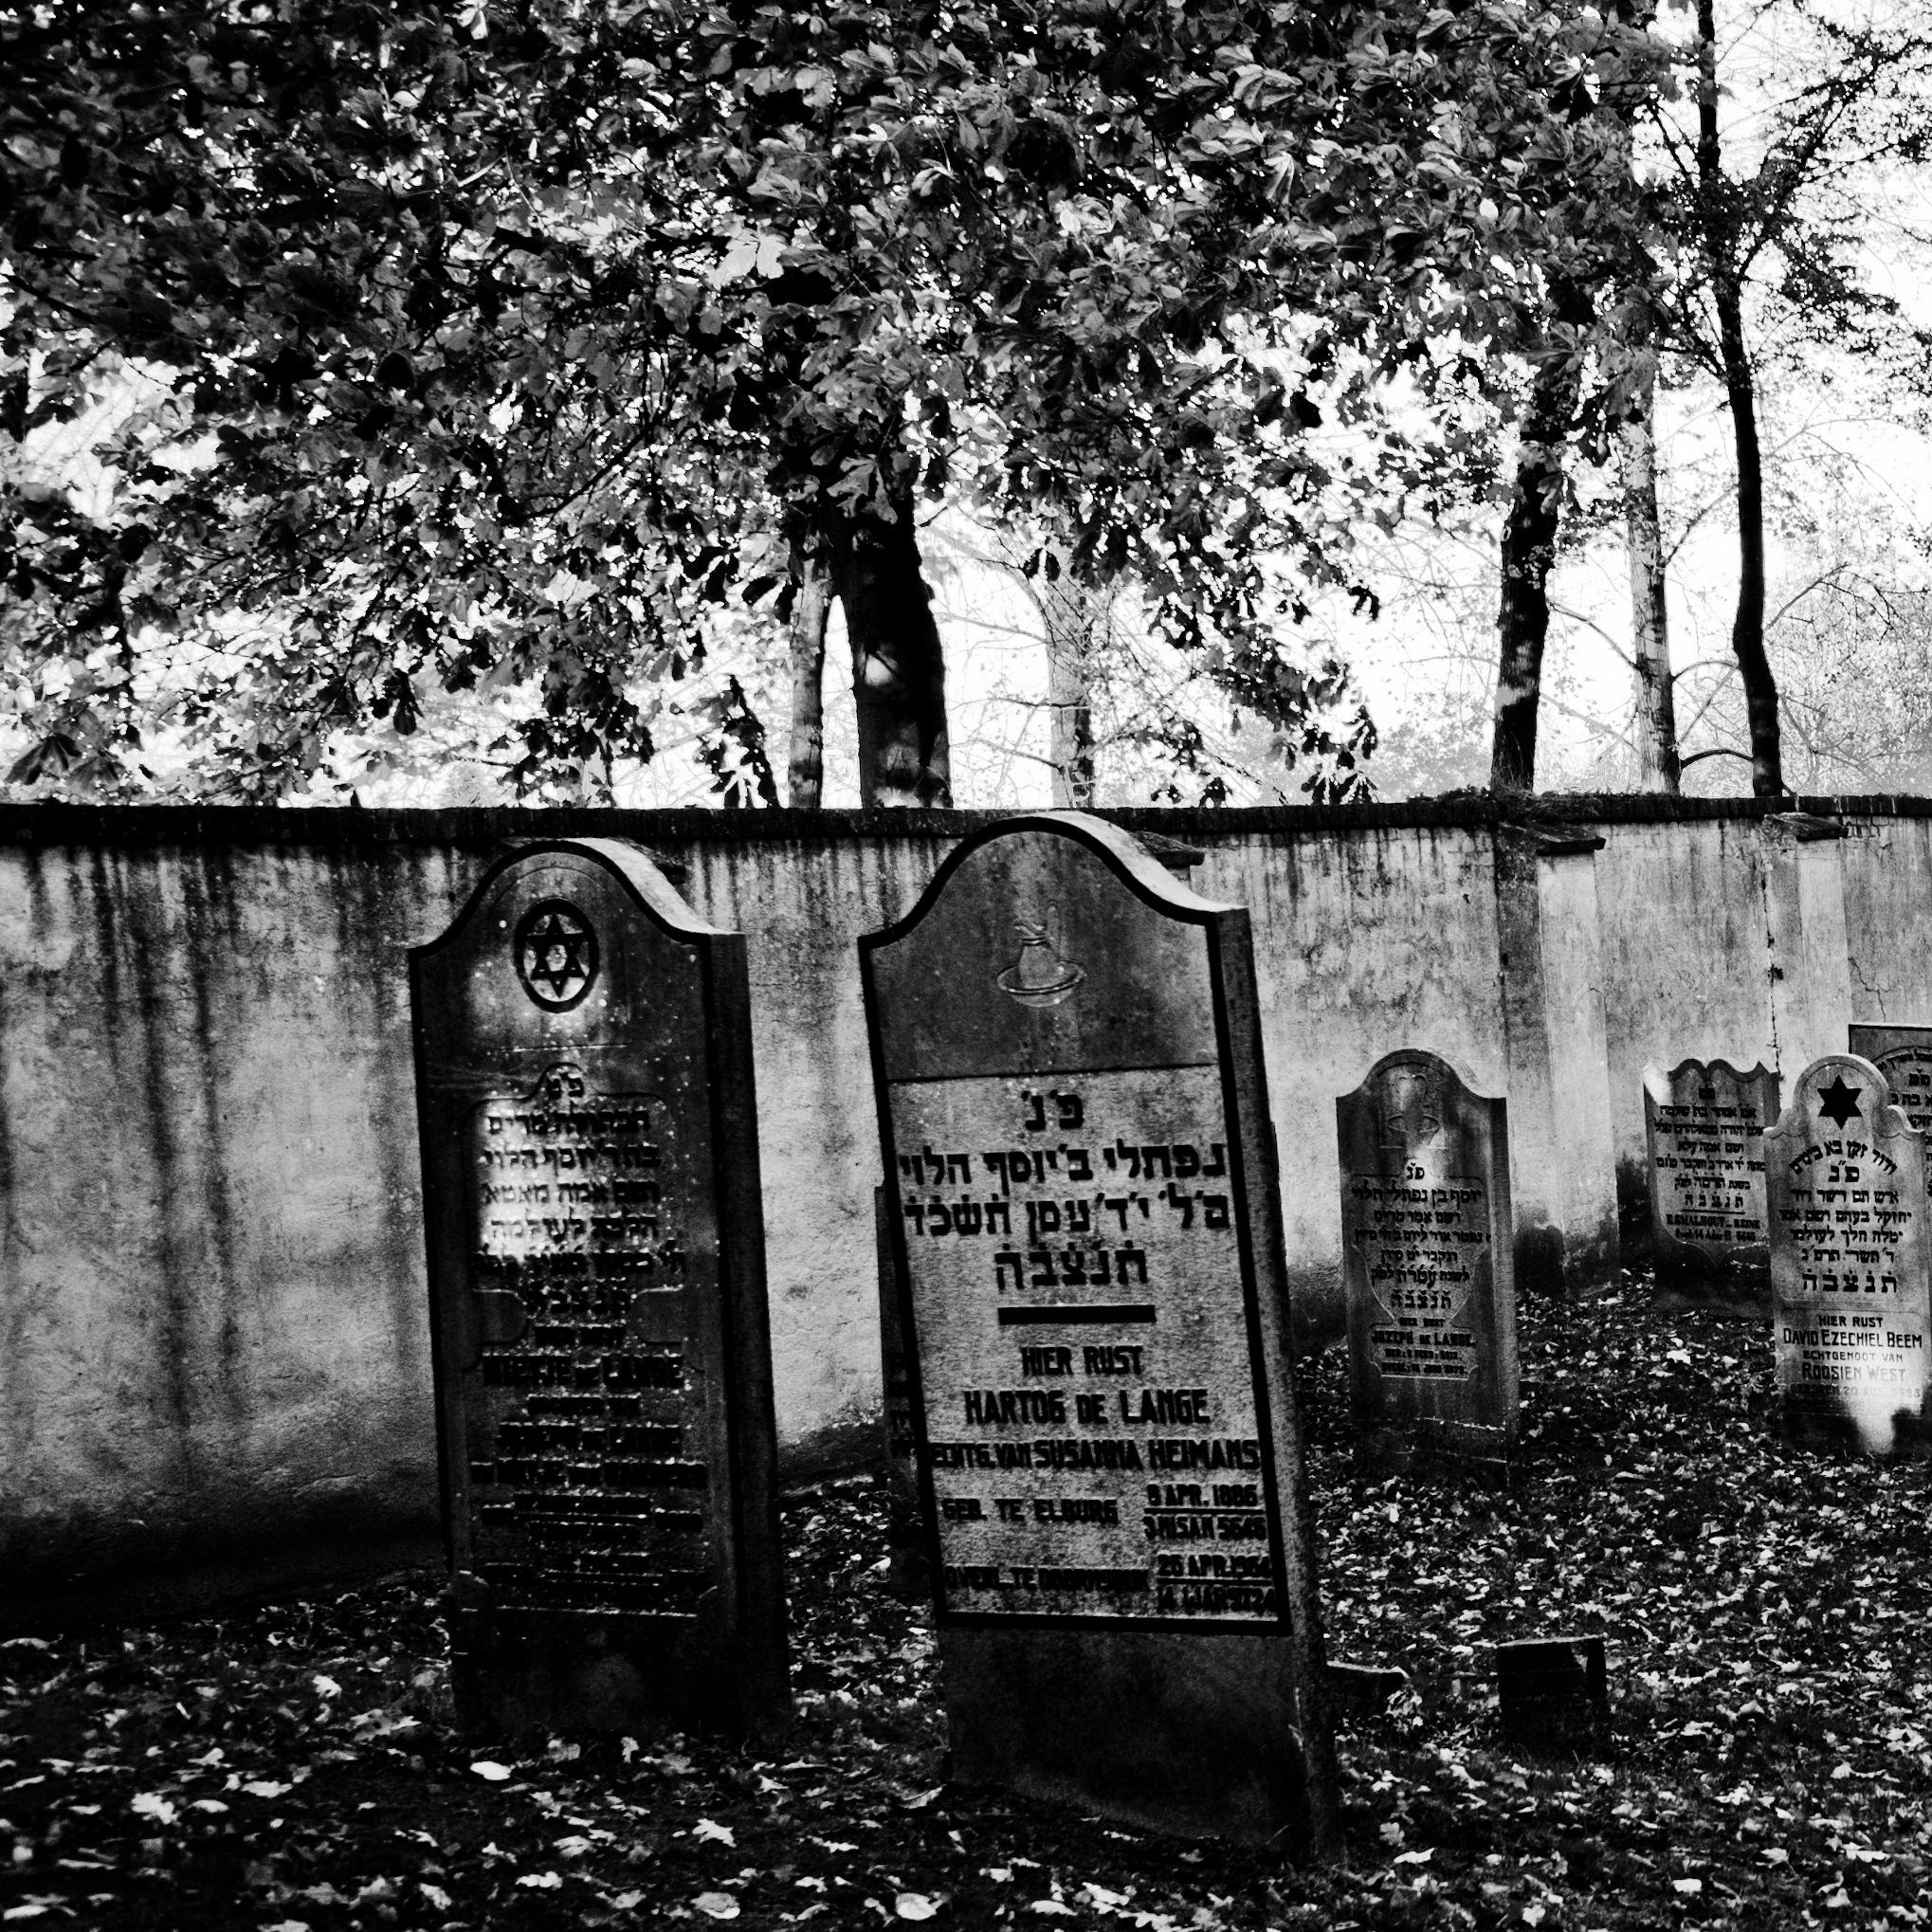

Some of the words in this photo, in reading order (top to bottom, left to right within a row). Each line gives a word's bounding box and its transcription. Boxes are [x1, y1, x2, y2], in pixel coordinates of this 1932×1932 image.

[1103, 1139, 1227, 1178] נפתלי
[1824, 1139, 1843, 1157] בא
[1846, 1140, 1868, 1159] זקן
[899, 1146, 972, 1185] הלוי
[1351, 1179, 1383, 1200] הלוי
[1387, 1179, 1428, 1202] נפתלי
[1431, 1189, 1448, 1209] בן
[1450, 1188, 1482, 1210] יוסף
[1816, 1190, 1847, 1203] וישר
[1852, 1190, 1869, 1203] תם
[1874, 1191, 1899, 1204] איש
[1026, 1199, 1090, 1246] ניסן
[1374, 1210, 1405, 1223] מרים
[1840, 1224, 1868, 1247] הלך
[1423, 1249, 1458, 1267] ונקבר
[1819, 1315, 1847, 1327] HIER
[1852, 1316, 1884, 1328] RUST
[1372, 1330, 1413, 1344] JOZEPH
[1419, 1334, 1431, 1344] DE
[1783, 1328, 1818, 1346] DAVID
[1821, 1329, 1885, 1347] EZECHIEL
[1886, 1331, 1923, 1349] BEEM
[1020, 1346, 1072, 1376] HIER
[1084, 1345, 1144, 1376] RUST
[1802, 1350, 1876, 1361] ECHTGENOOT
[1882, 1353, 1904, 1362] VAN
[604, 1356, 683, 1387] LANGE
[1801, 1362, 1862, 1380] ROOSIEN
[1867, 1365, 1906, 1382] WEST
[964, 1390, 1066, 1424] HARTOG
[1076, 1394, 1108, 1424] DE
[1119, 1389, 1212, 1424] LANGE
[1032, 1438, 1144, 1470] SUSANNA
[1148, 1438, 1261, 1469] HEIMANS
[1165, 1484, 1209, 1506] APR.
[1212, 1484, 1258, 1507] 1886
[941, 1498, 988, 1522] GEB.
[994, 1498, 1025, 1522] TE
[1033, 1498, 1119, 1524] ELBURG
[1158, 1517, 1215, 1540] NISAN
[1010, 1567, 1036, 1591] TE
